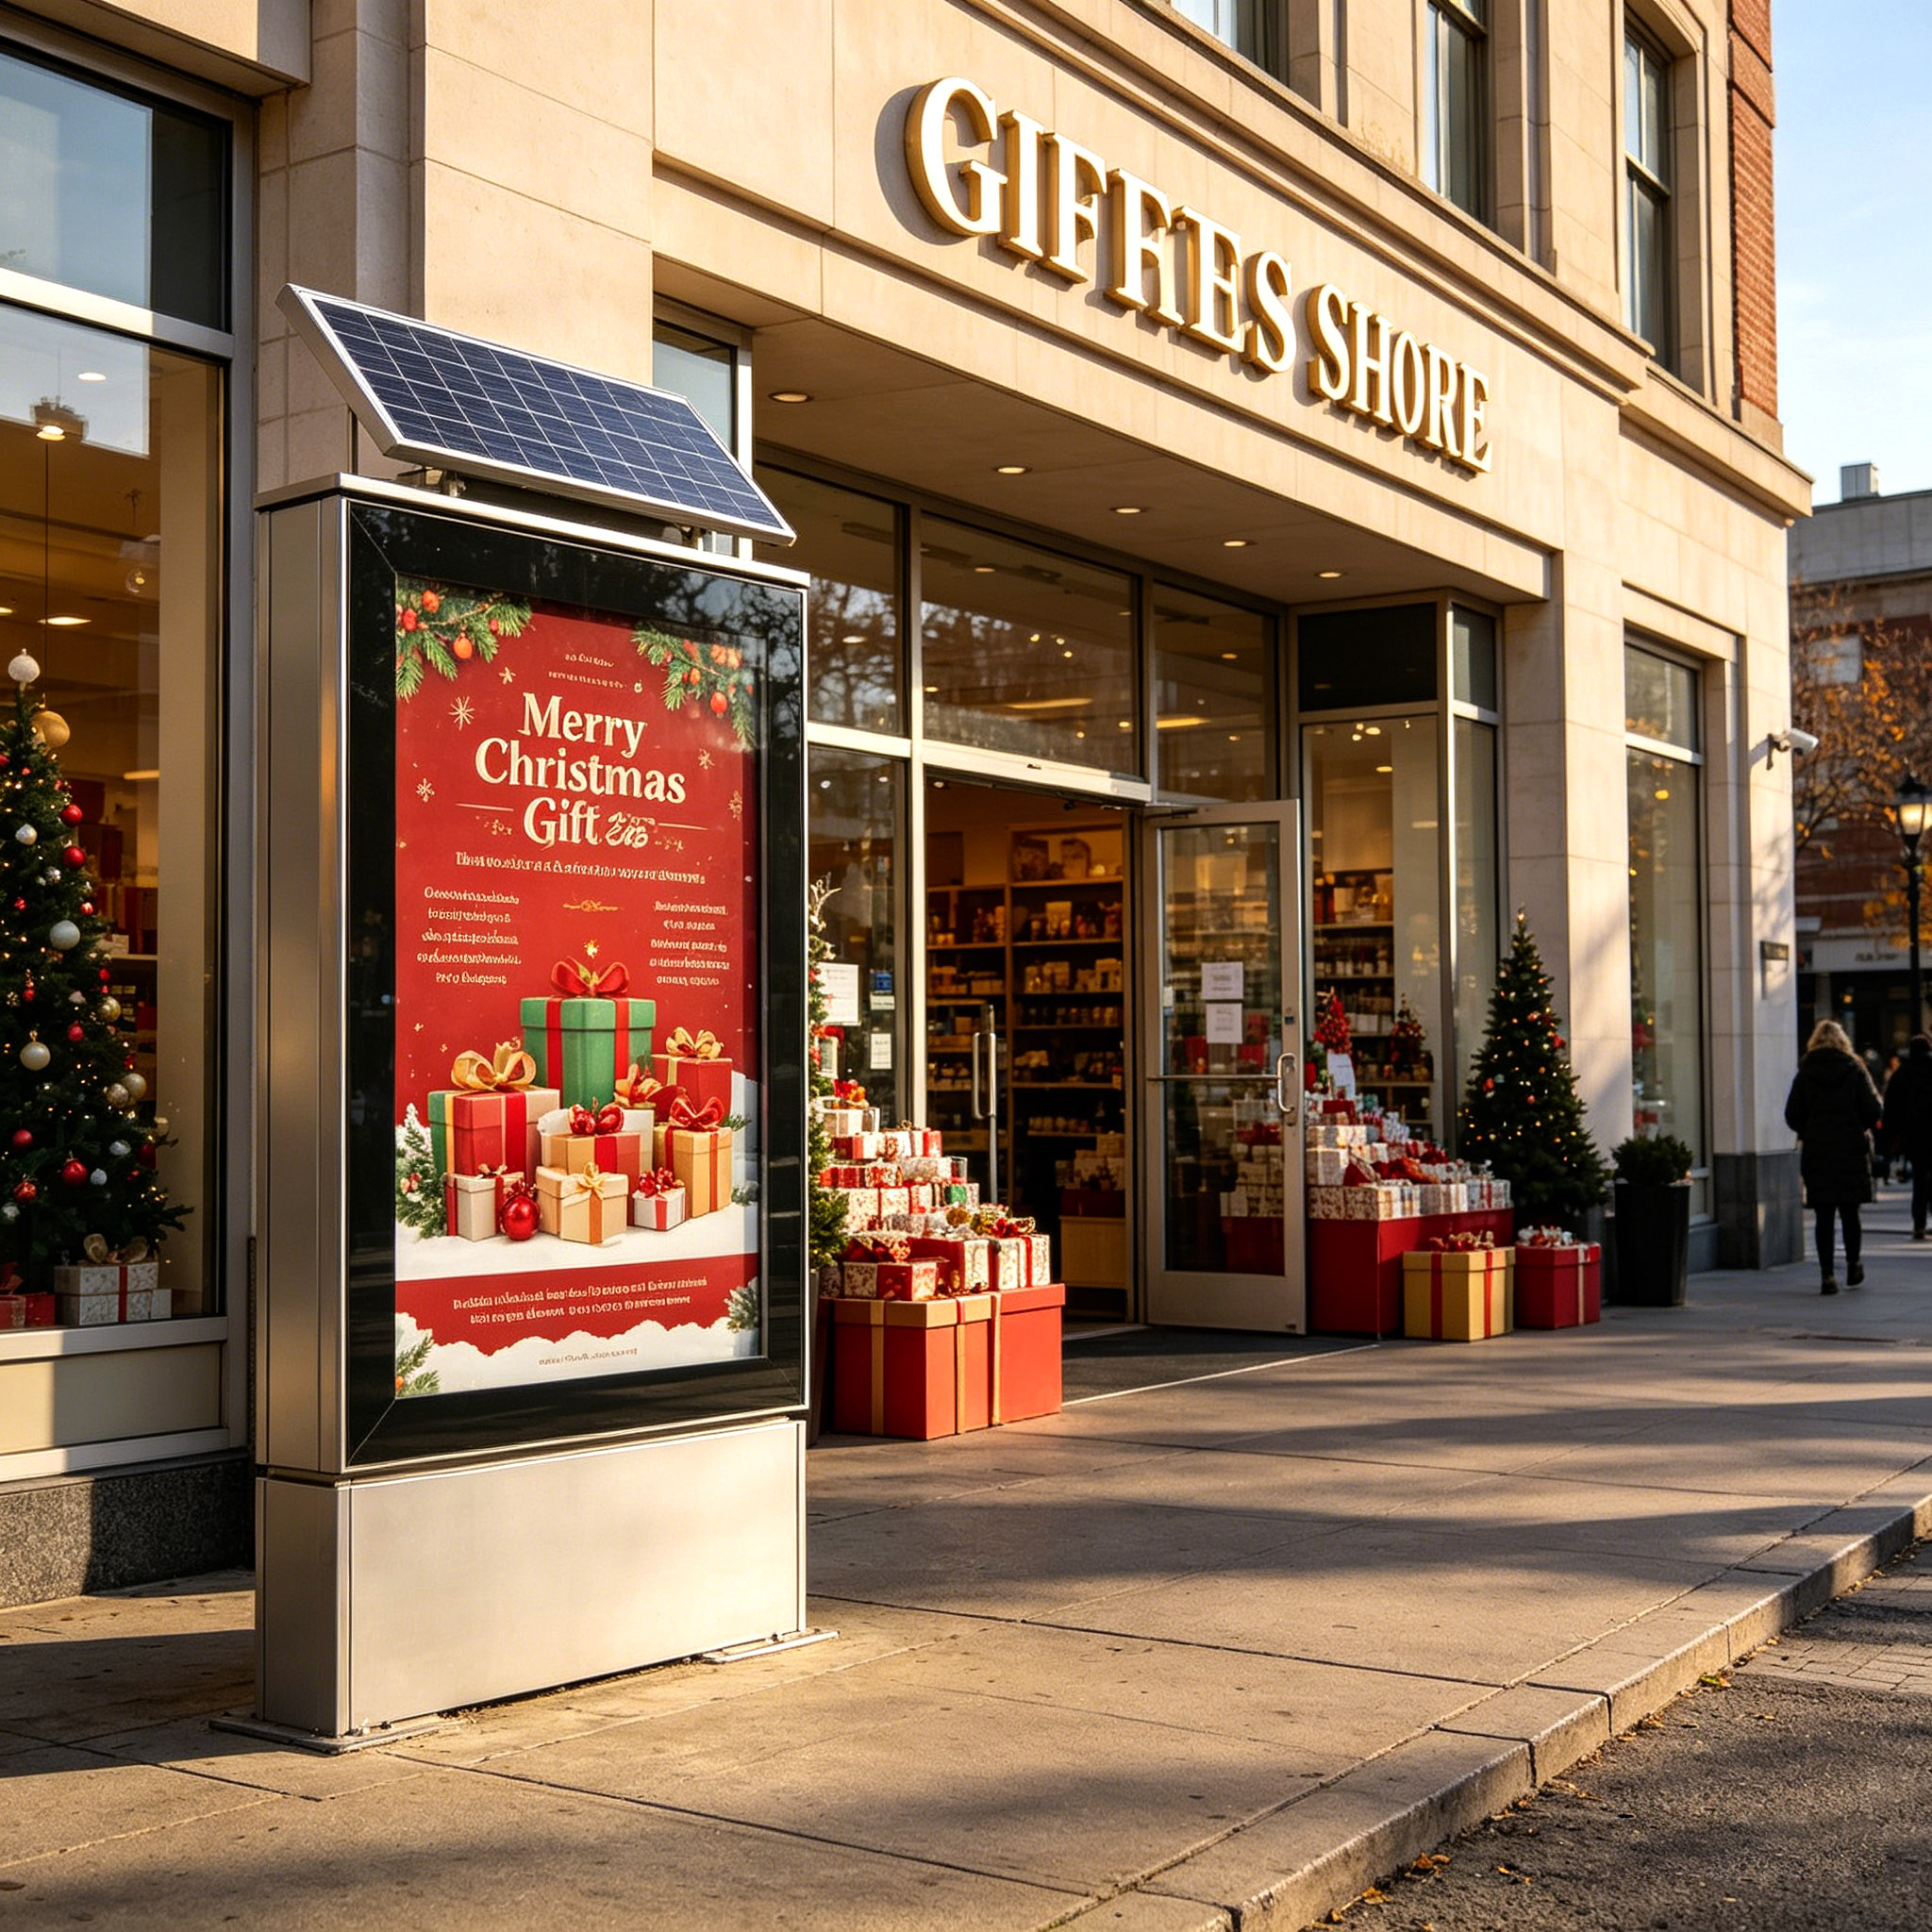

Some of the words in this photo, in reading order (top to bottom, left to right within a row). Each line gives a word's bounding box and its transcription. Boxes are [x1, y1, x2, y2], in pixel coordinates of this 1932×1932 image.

[1307, 283, 1492, 474] SHORE
[518, 691, 648, 758] Merry
[475, 737, 687, 804] Christmas
[523, 797, 602, 849] Gift
